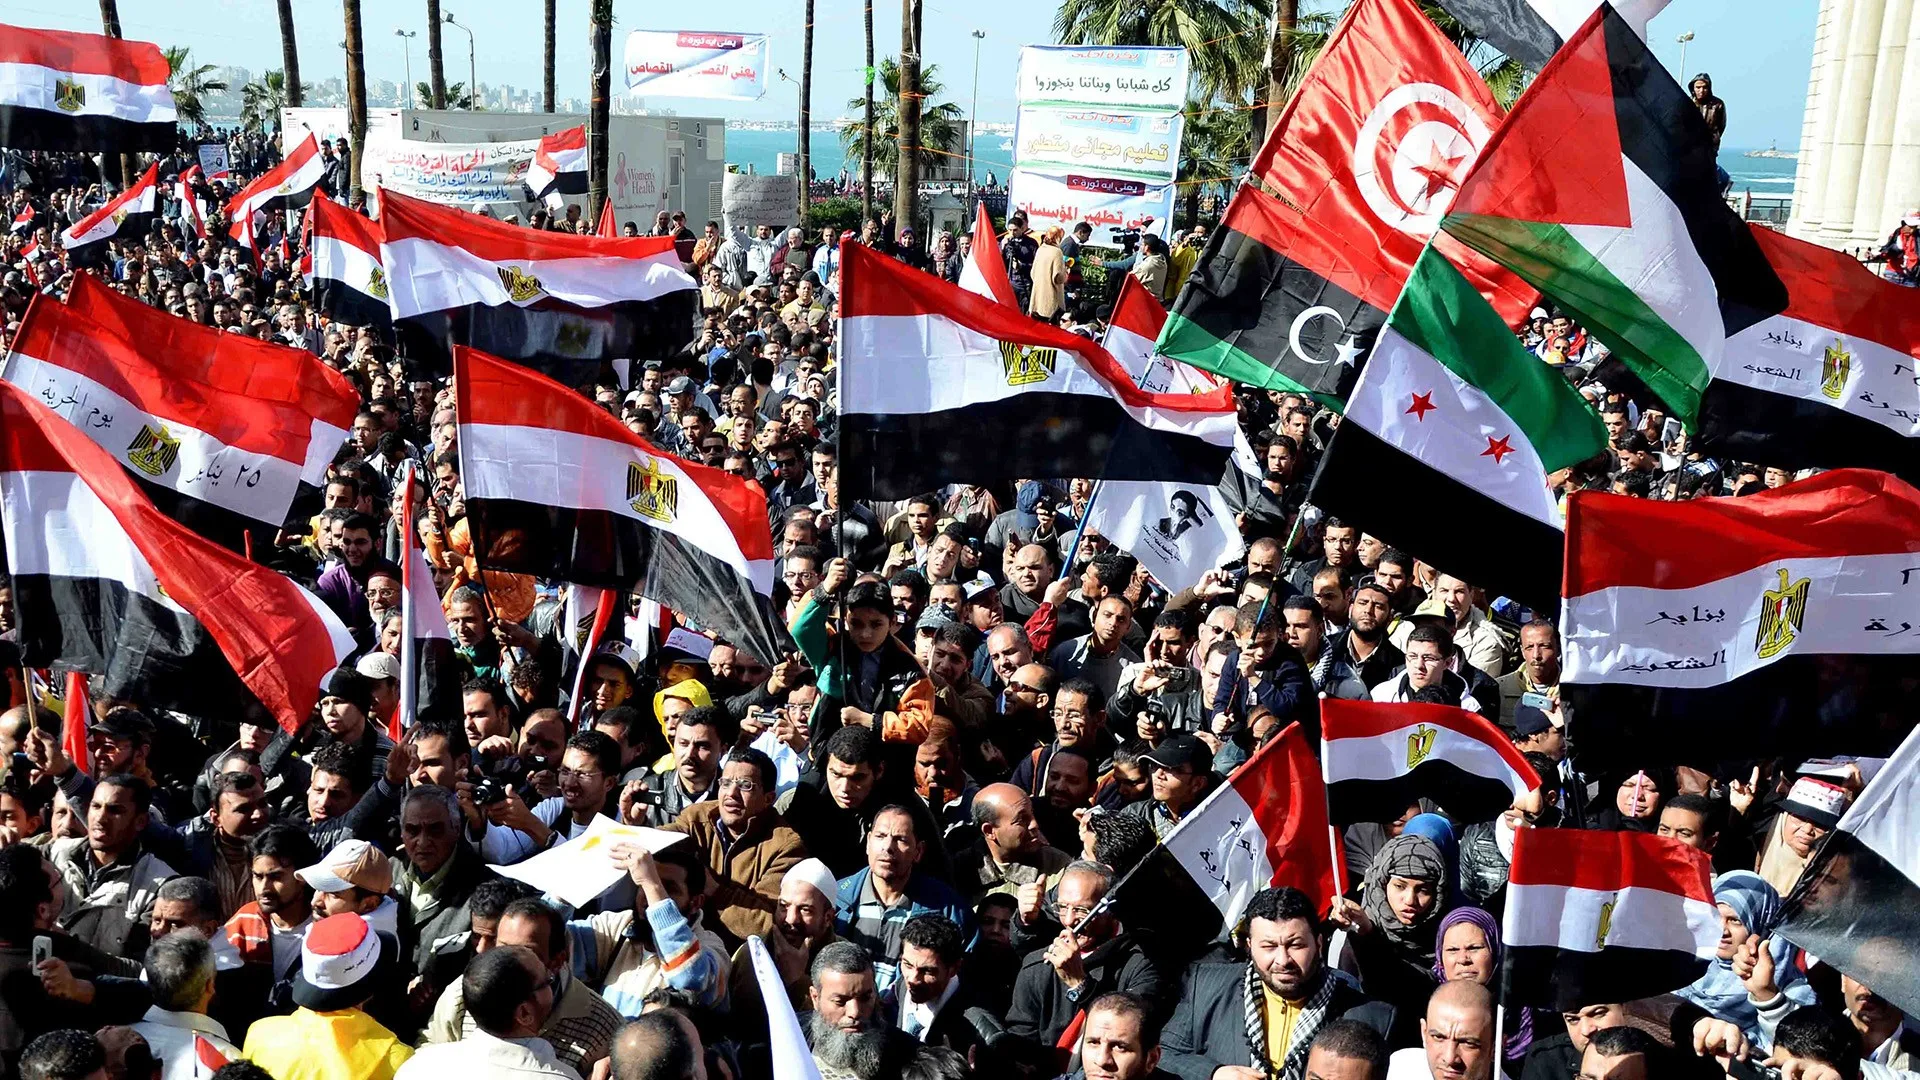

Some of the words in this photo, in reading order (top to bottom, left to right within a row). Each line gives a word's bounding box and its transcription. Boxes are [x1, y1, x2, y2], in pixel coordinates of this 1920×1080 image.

[630, 61, 674, 75] القصاص
[1035, 75, 1074, 91] يتجوزوا
[1079, 76, 1111, 93] وبناتنا
[1116, 77, 1149, 93] شبابنا
[1152, 77, 1172, 93] كل
[1023, 133, 1070, 155] متطور
[1123, 142, 1169, 164] تعليم
[627, 168, 655, 181] Women's
[632, 181, 655, 194] Health
[1080, 179, 1100, 190] ثورة
[1114, 183, 1138, 194] يعنى
[1084, 209, 1123, 226] تطهير
[1762, 331, 1803, 349] يناير
[1743, 363, 1801, 381] الشعب
[41, 378, 88, 410] الحرية
[85, 405, 113, 429] يوم
[185, 454, 223, 487] يناير
[234, 468, 261, 488] ٢٥
[1645, 605, 1726, 627] يناير
[1619, 649, 1727, 674] الشعب
